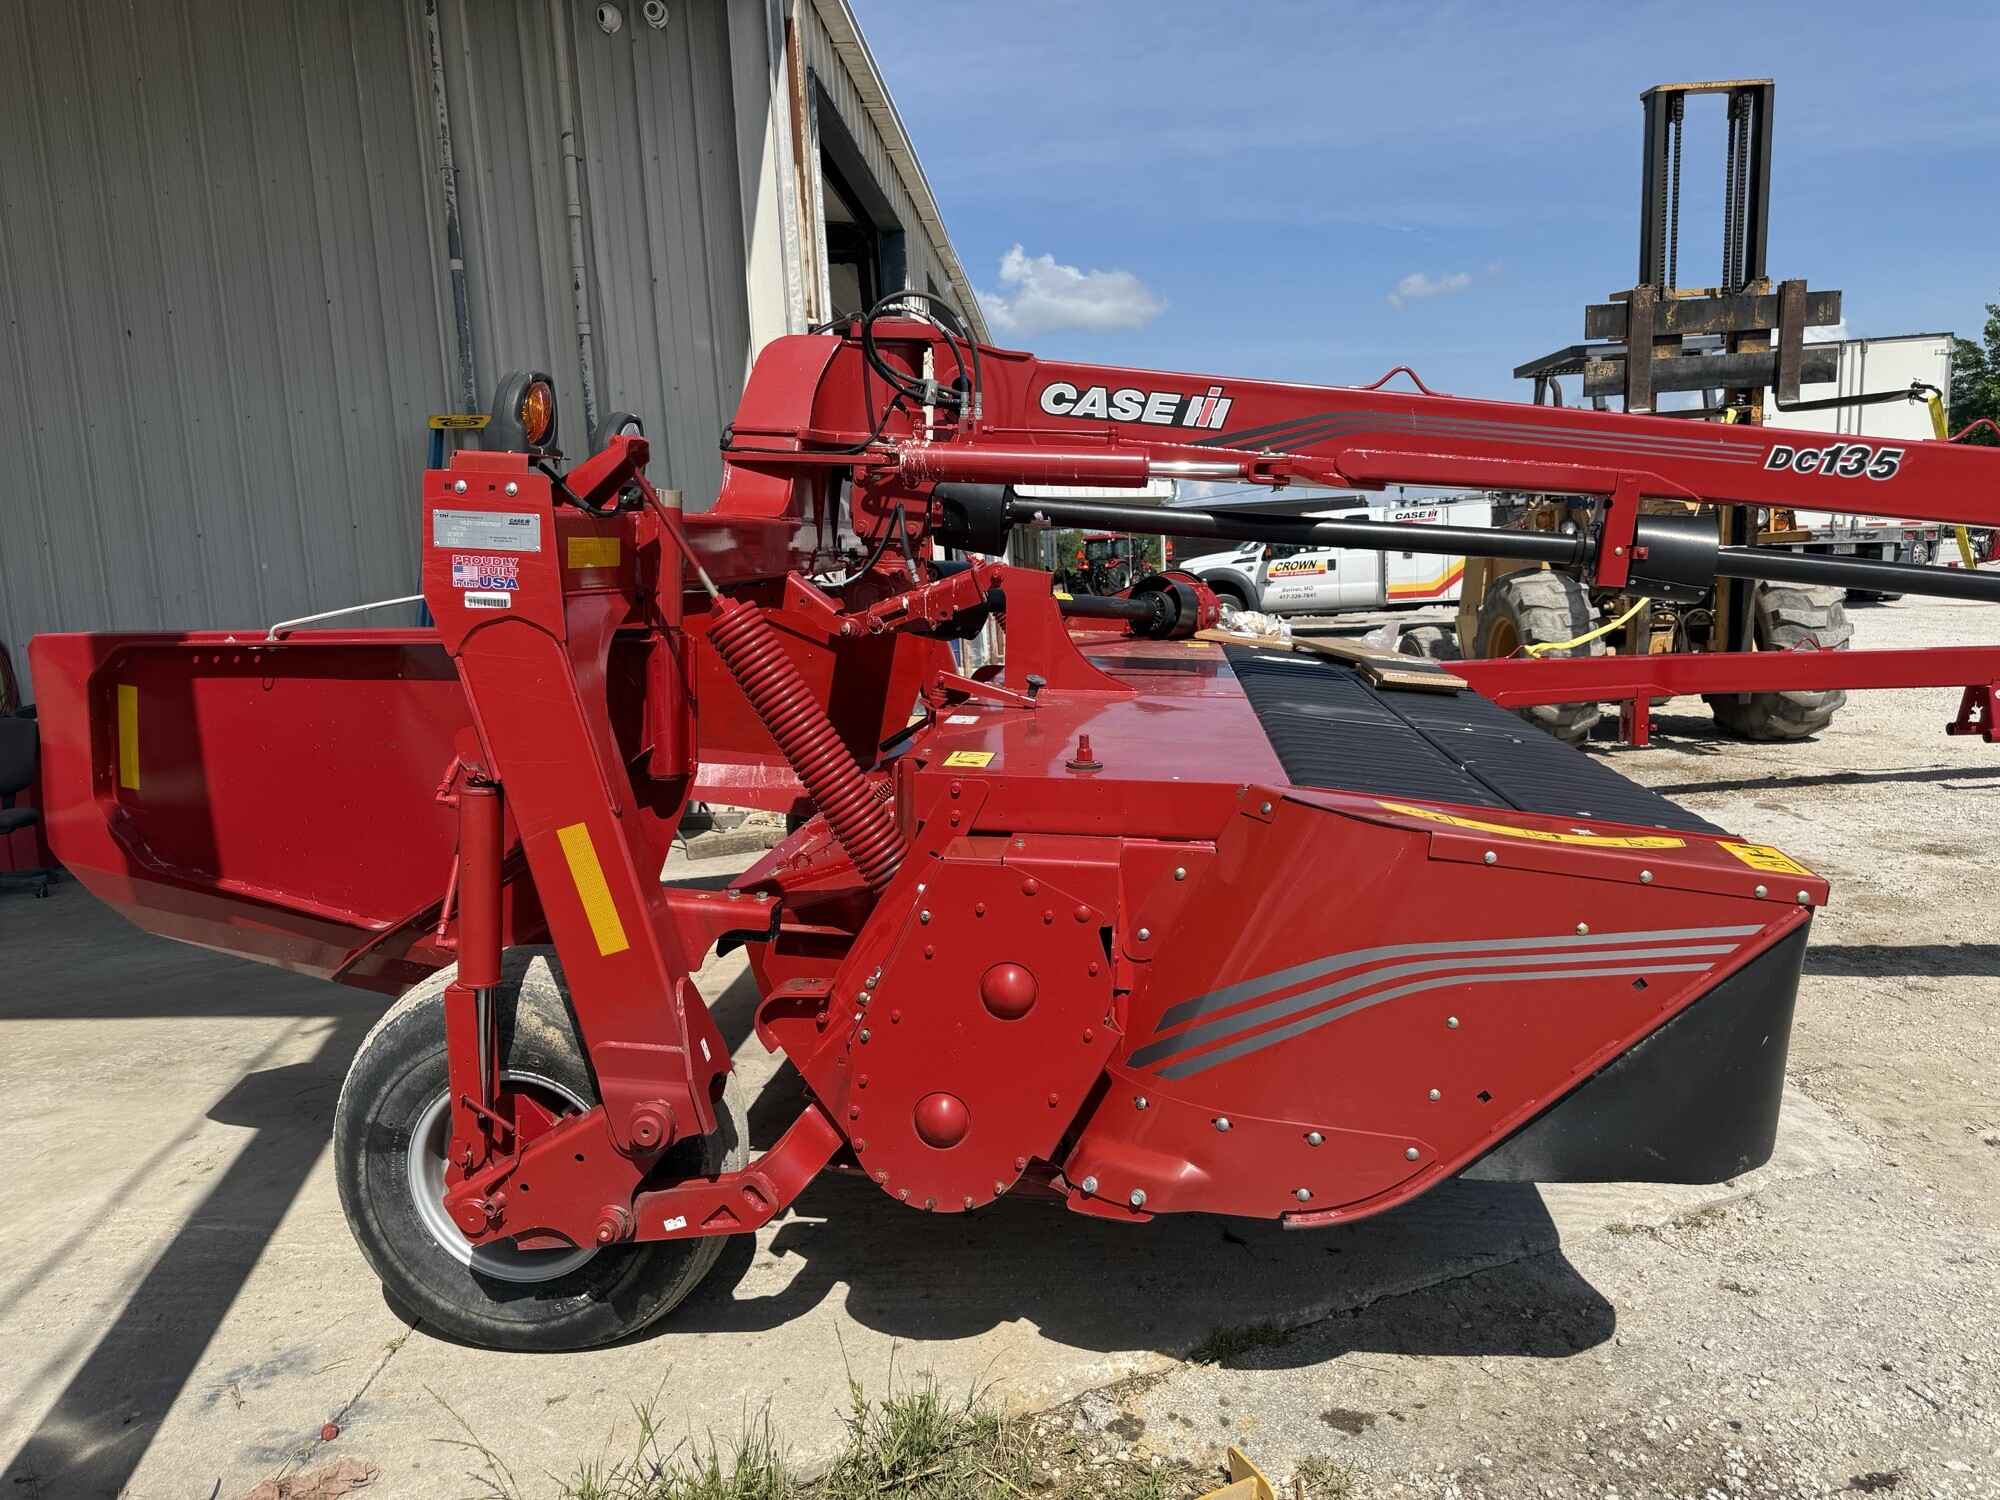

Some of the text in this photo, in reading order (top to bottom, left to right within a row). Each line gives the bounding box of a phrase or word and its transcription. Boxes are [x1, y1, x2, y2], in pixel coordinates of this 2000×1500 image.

[1040, 382, 1181, 425] CASE
[1763, 442, 1906, 480] DC135
[1395, 511, 1427, 520] CASE
[452, 555, 519, 567] PROUDLY
[1275, 559, 1318, 571] CROWN
[480, 566, 519, 577] BUILT
[454, 577, 518, 589] in the USA
